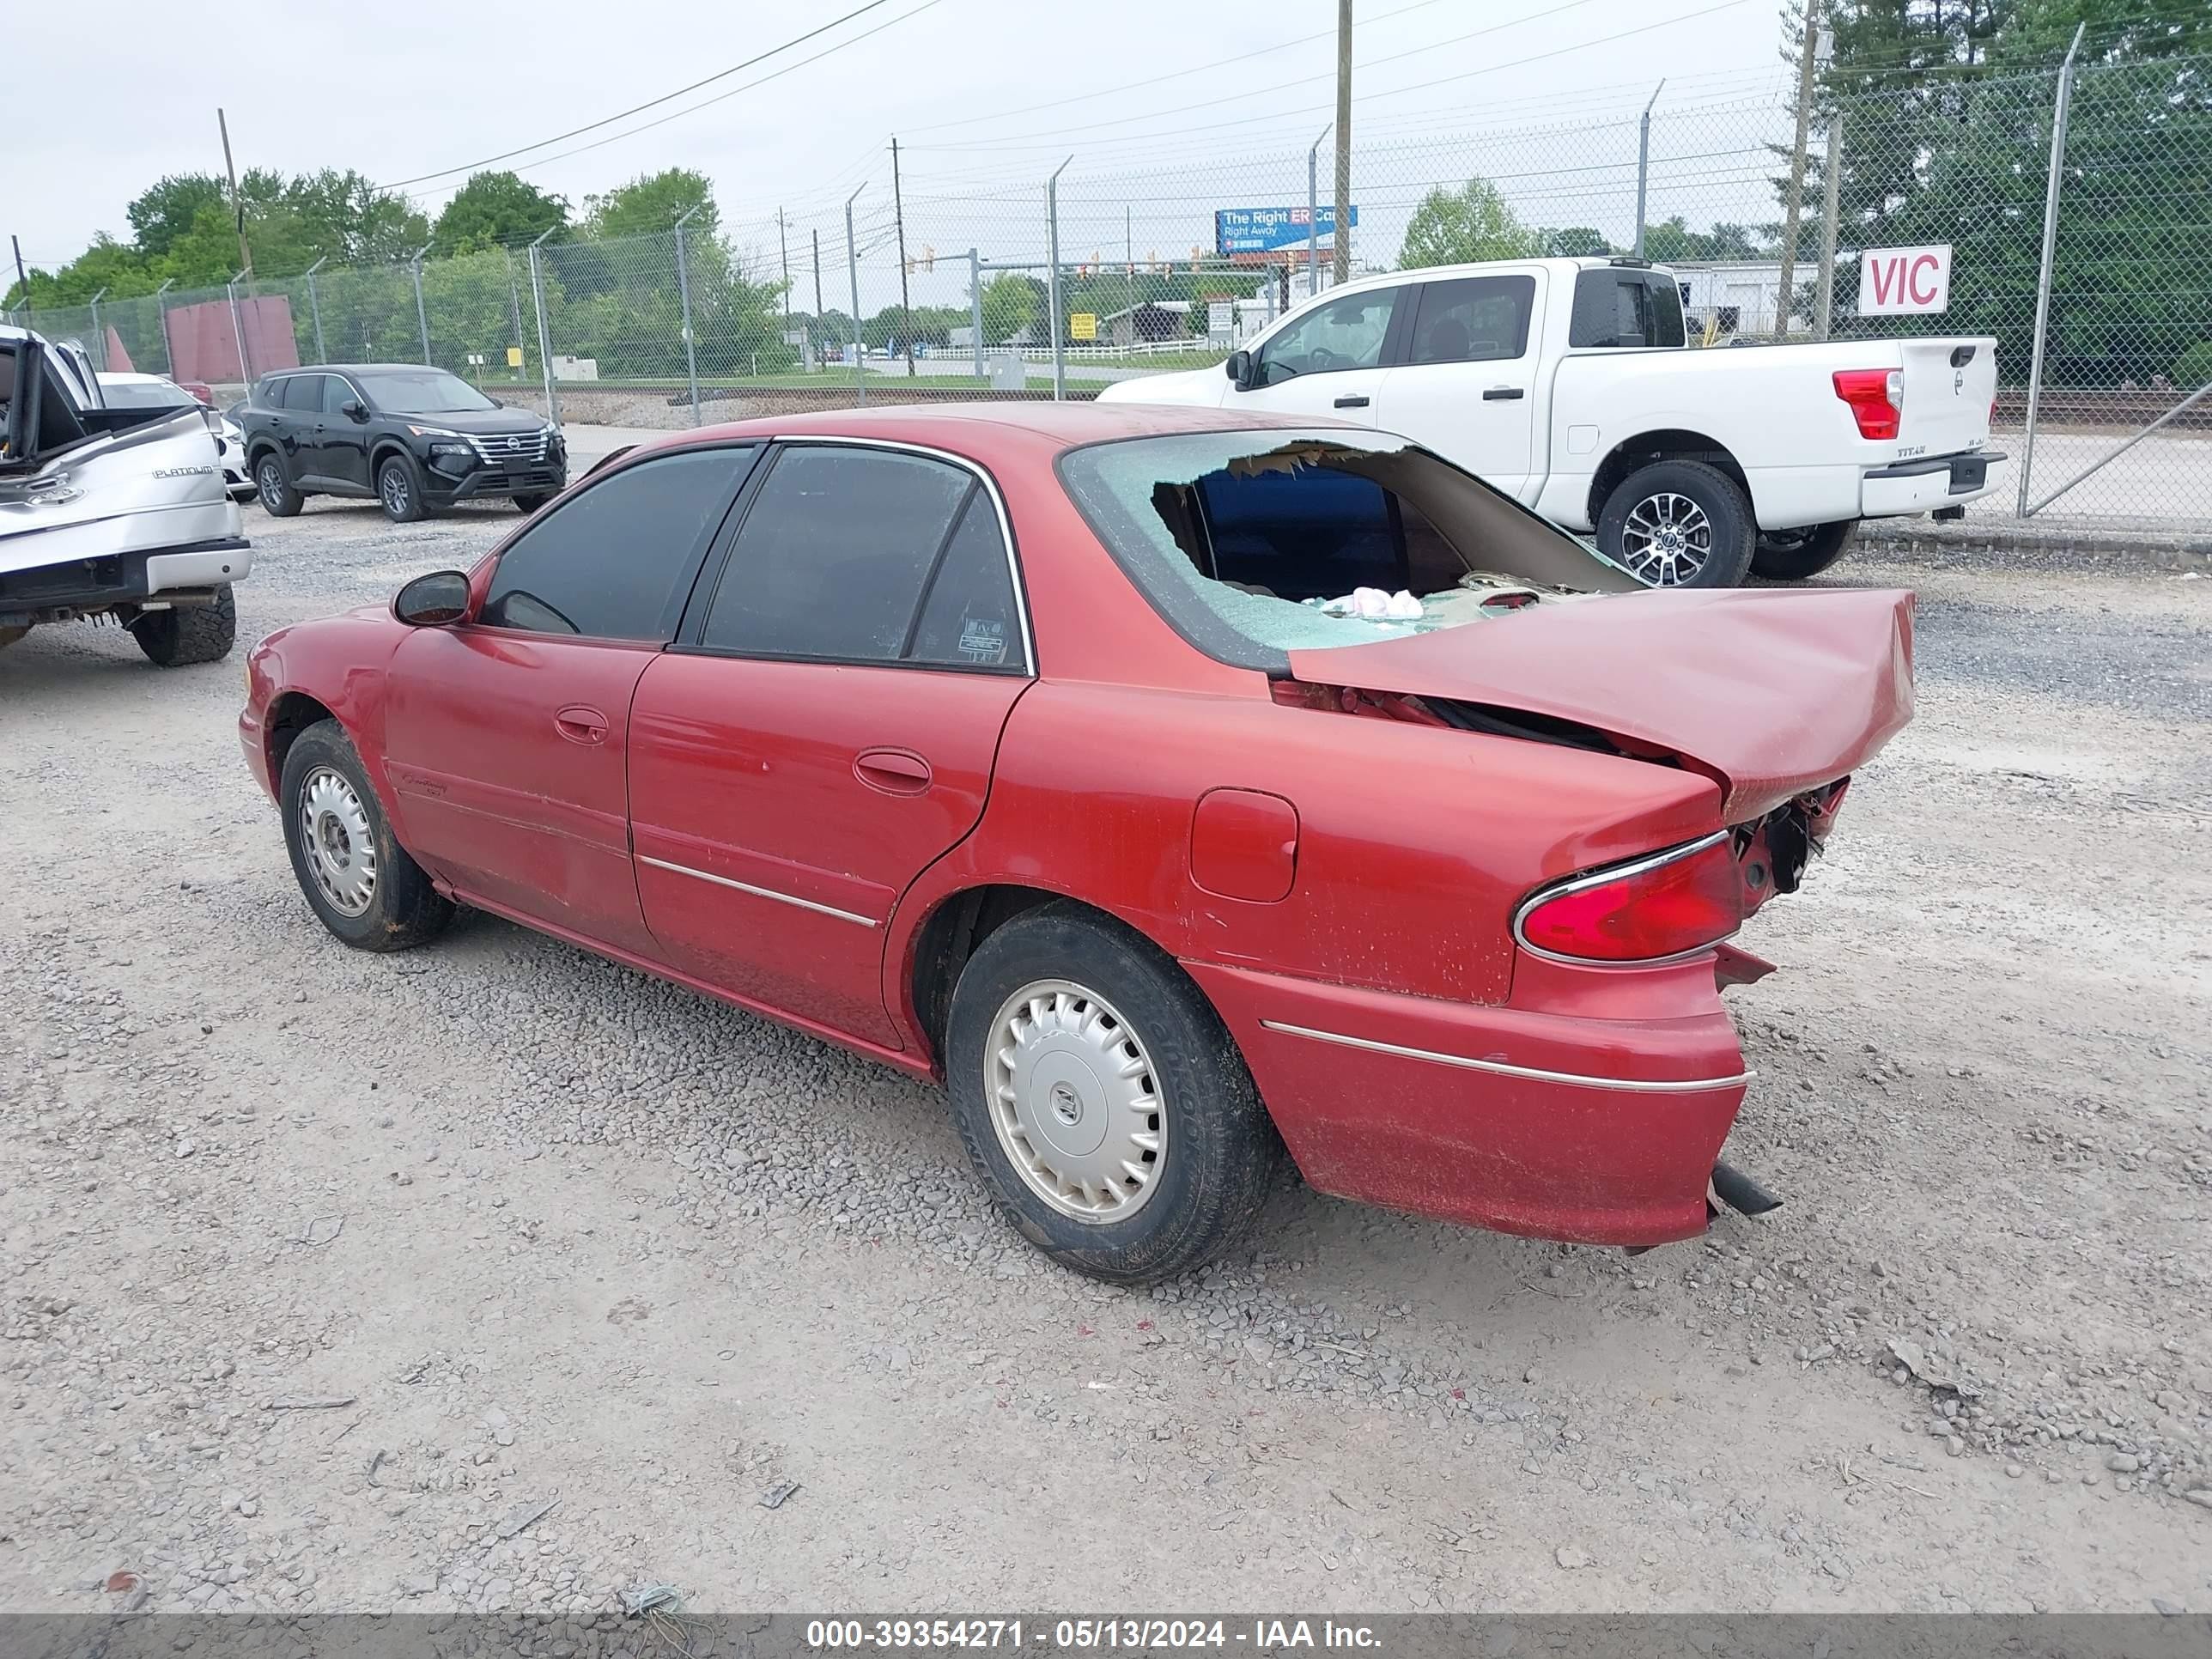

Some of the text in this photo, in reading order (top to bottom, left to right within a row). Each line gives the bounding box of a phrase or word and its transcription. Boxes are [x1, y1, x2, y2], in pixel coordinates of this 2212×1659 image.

[1224, 211, 1250, 224] The
[1253, 210, 1288, 226] Right
[1291, 209, 1310, 222] ER
[1224, 224, 1278, 238] Right Away
[1871, 254, 1939, 306] VIC
[1897, 445, 1926, 458] TITAN
[153, 465, 213, 479] PLATINUM
